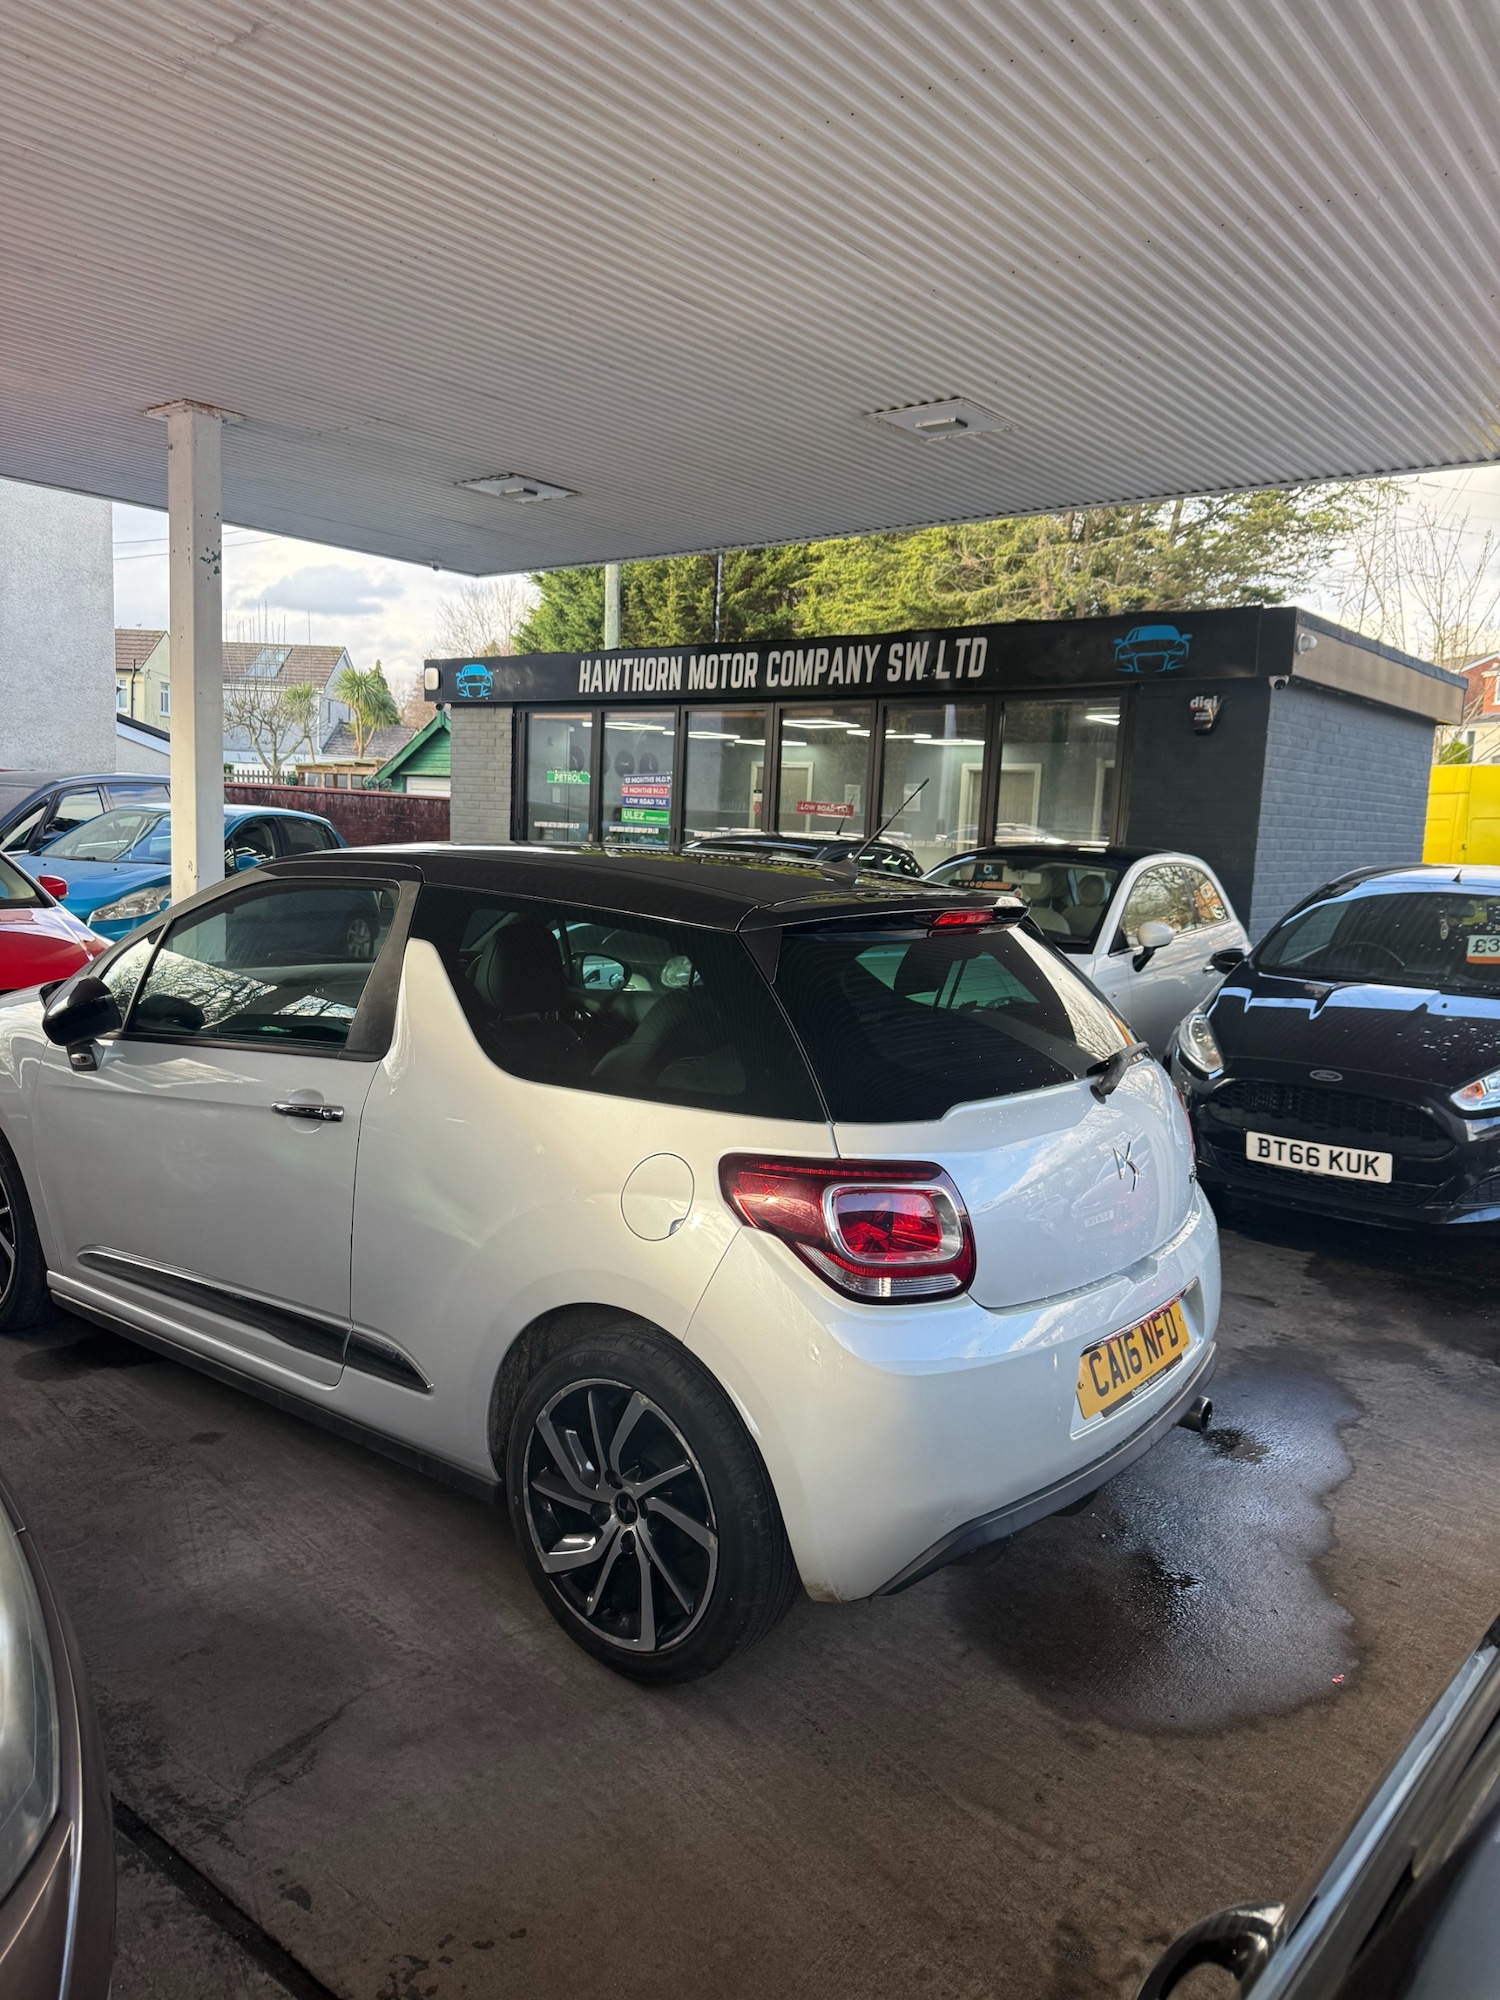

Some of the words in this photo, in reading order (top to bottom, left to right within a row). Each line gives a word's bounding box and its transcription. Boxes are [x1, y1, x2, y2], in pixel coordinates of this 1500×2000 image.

[578, 655, 683, 694] HAWTHORN
[687, 652, 759, 691] MOTOR
[765, 644, 882, 688] COMPANY
[886, 640, 930, 682] SW
[934, 636, 988, 680] LTD
[1189, 695, 1218, 710] digi
[554, 772, 583, 783] PETROL
[629, 786, 652, 795] MONTHS
[639, 797, 655, 805] ROAD
[655, 798, 667, 806] TAX
[799, 803, 816, 811] LOW
[816, 803, 836, 813] ROAD
[623, 809, 645, 821] ULEZ
[1257, 1137, 1321, 1168] BT66
[1328, 1150, 1380, 1177] KUK
[1088, 1331, 1143, 1398] CA16
[1139, 1307, 1179, 1365] NFD
